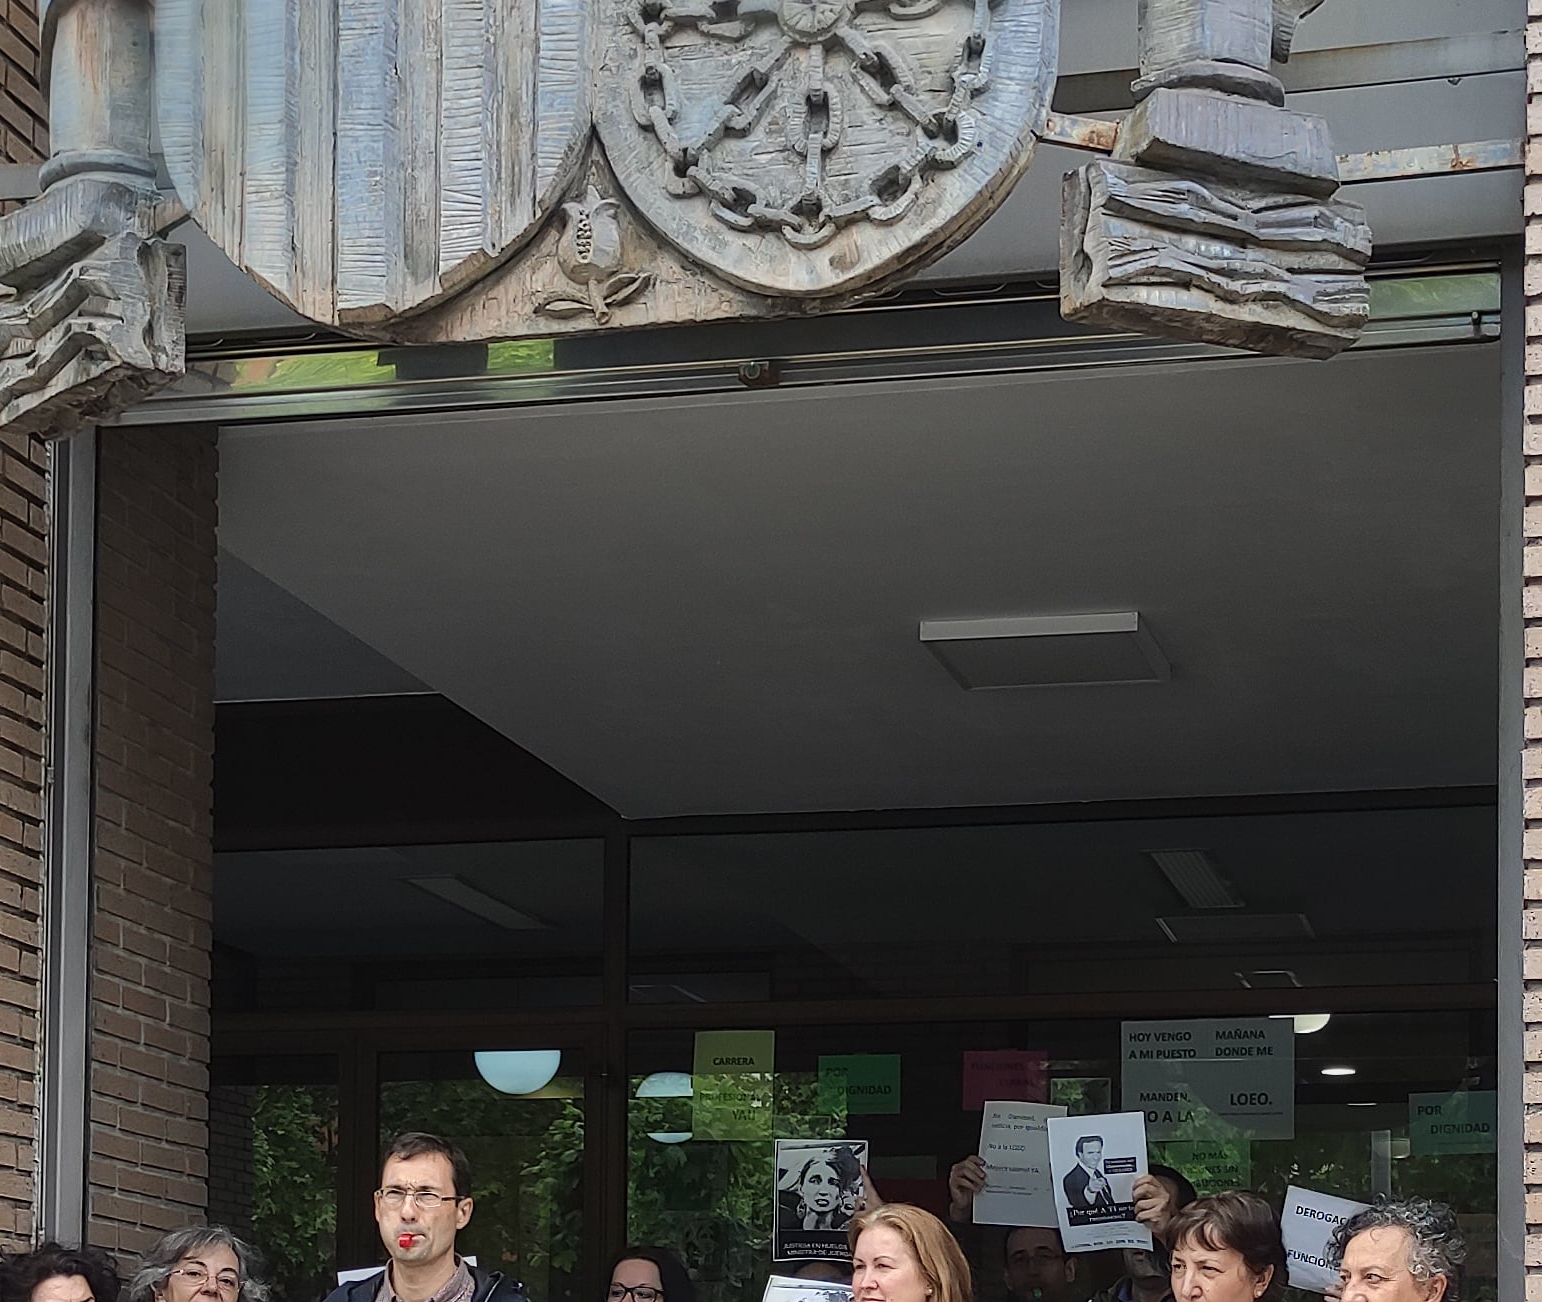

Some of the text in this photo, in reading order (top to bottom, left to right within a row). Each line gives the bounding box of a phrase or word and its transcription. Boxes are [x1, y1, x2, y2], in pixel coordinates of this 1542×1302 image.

[1129, 1031, 1192, 1043] HOY VENGO
[1215, 1028, 1266, 1040] MAÑANA
[1128, 1049, 1197, 1060] A MI PUESTO
[1215, 1046, 1274, 1057] DONDE ME
[712, 1057, 755, 1066] CARRERA
[837, 1085, 891, 1095] DIGNIDAD
[1230, 1093, 1273, 1106] LOEO.
[1417, 1105, 1443, 1116] POR
[1162, 1111, 1196, 1123] A LA
[1430, 1122, 1490, 1135] DIGNIDAD
[1295, 1205, 1348, 1226] DEROGAC
